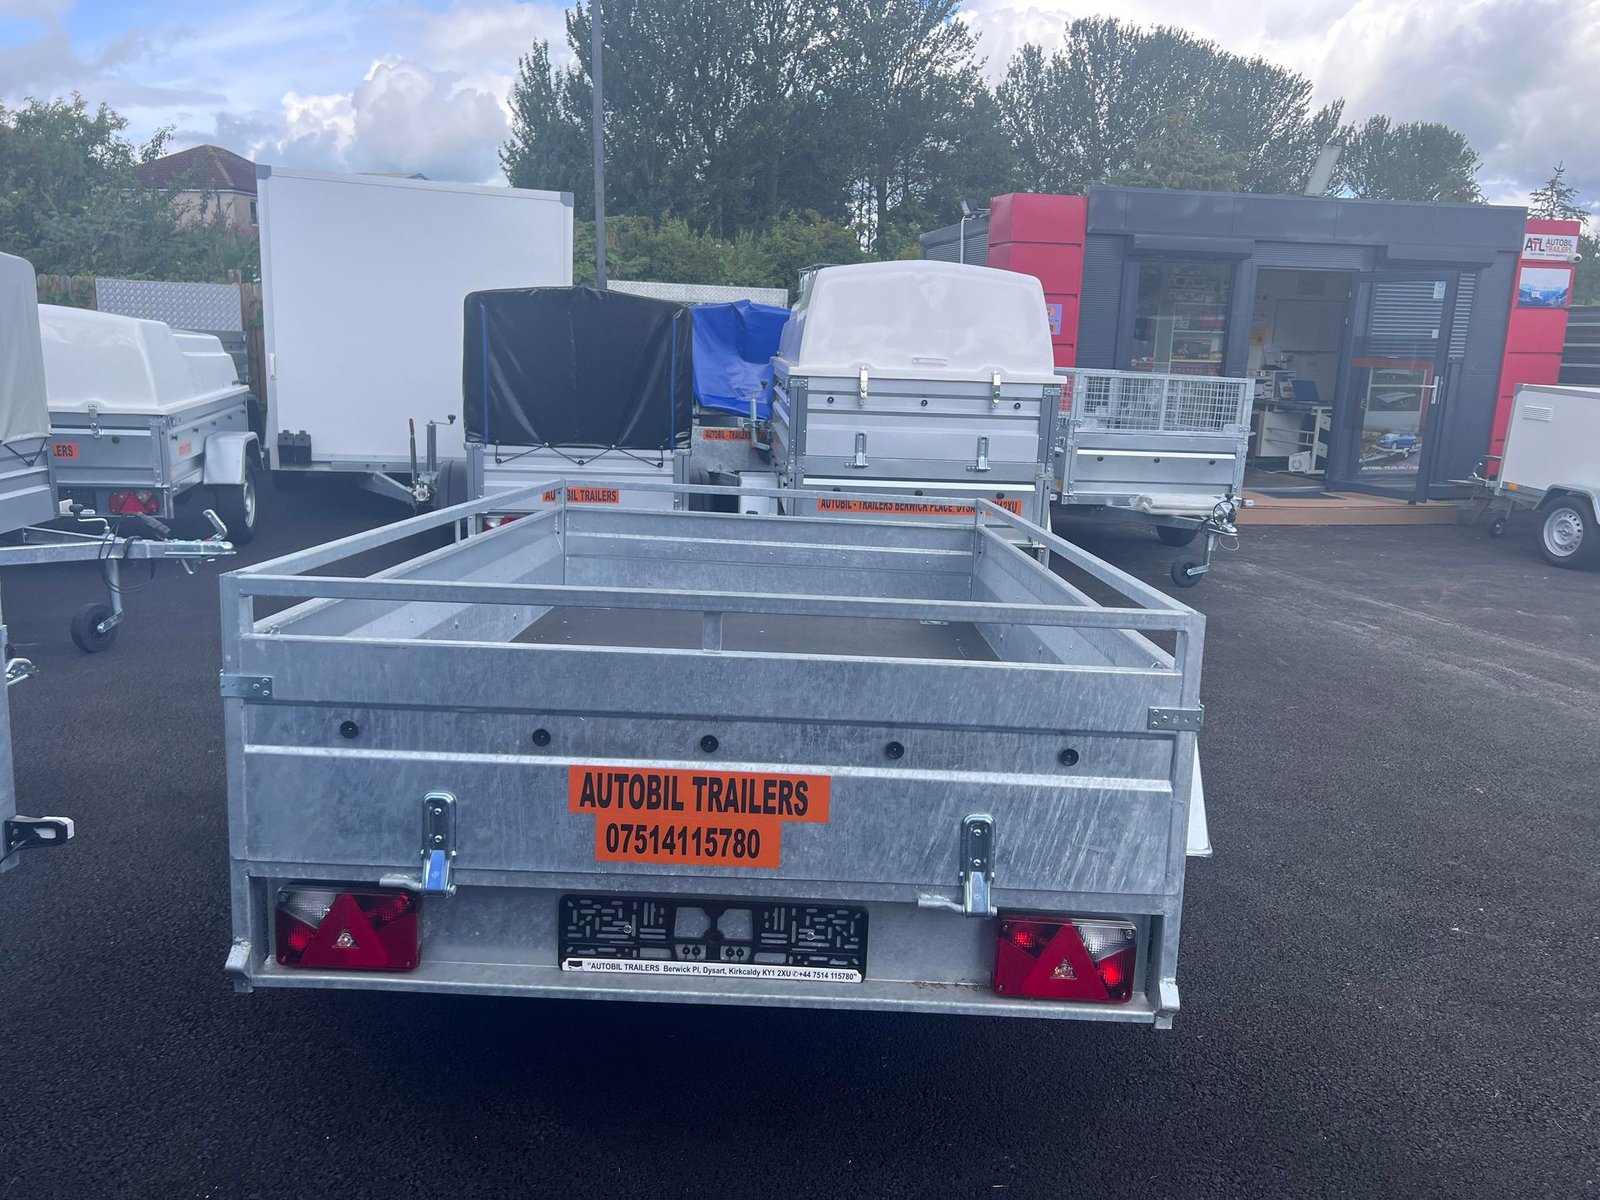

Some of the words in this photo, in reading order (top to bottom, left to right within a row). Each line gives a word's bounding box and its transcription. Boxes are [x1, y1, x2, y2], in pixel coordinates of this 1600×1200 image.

[1546, 238, 1573, 247] AUTOBIL
[580, 490, 617, 502] TRAILERS
[579, 772, 684, 811] AUTOBIL
[692, 777, 809, 816] TRAILERS
[606, 823, 760, 859] 07514115780
[624, 963, 660, 972] TRAILERS
[703, 967, 727, 975] Dysart,
[728, 968, 761, 977] Kirkcaldy
[762, 969, 775, 977] KY1
[813, 971, 828, 979] 7514
